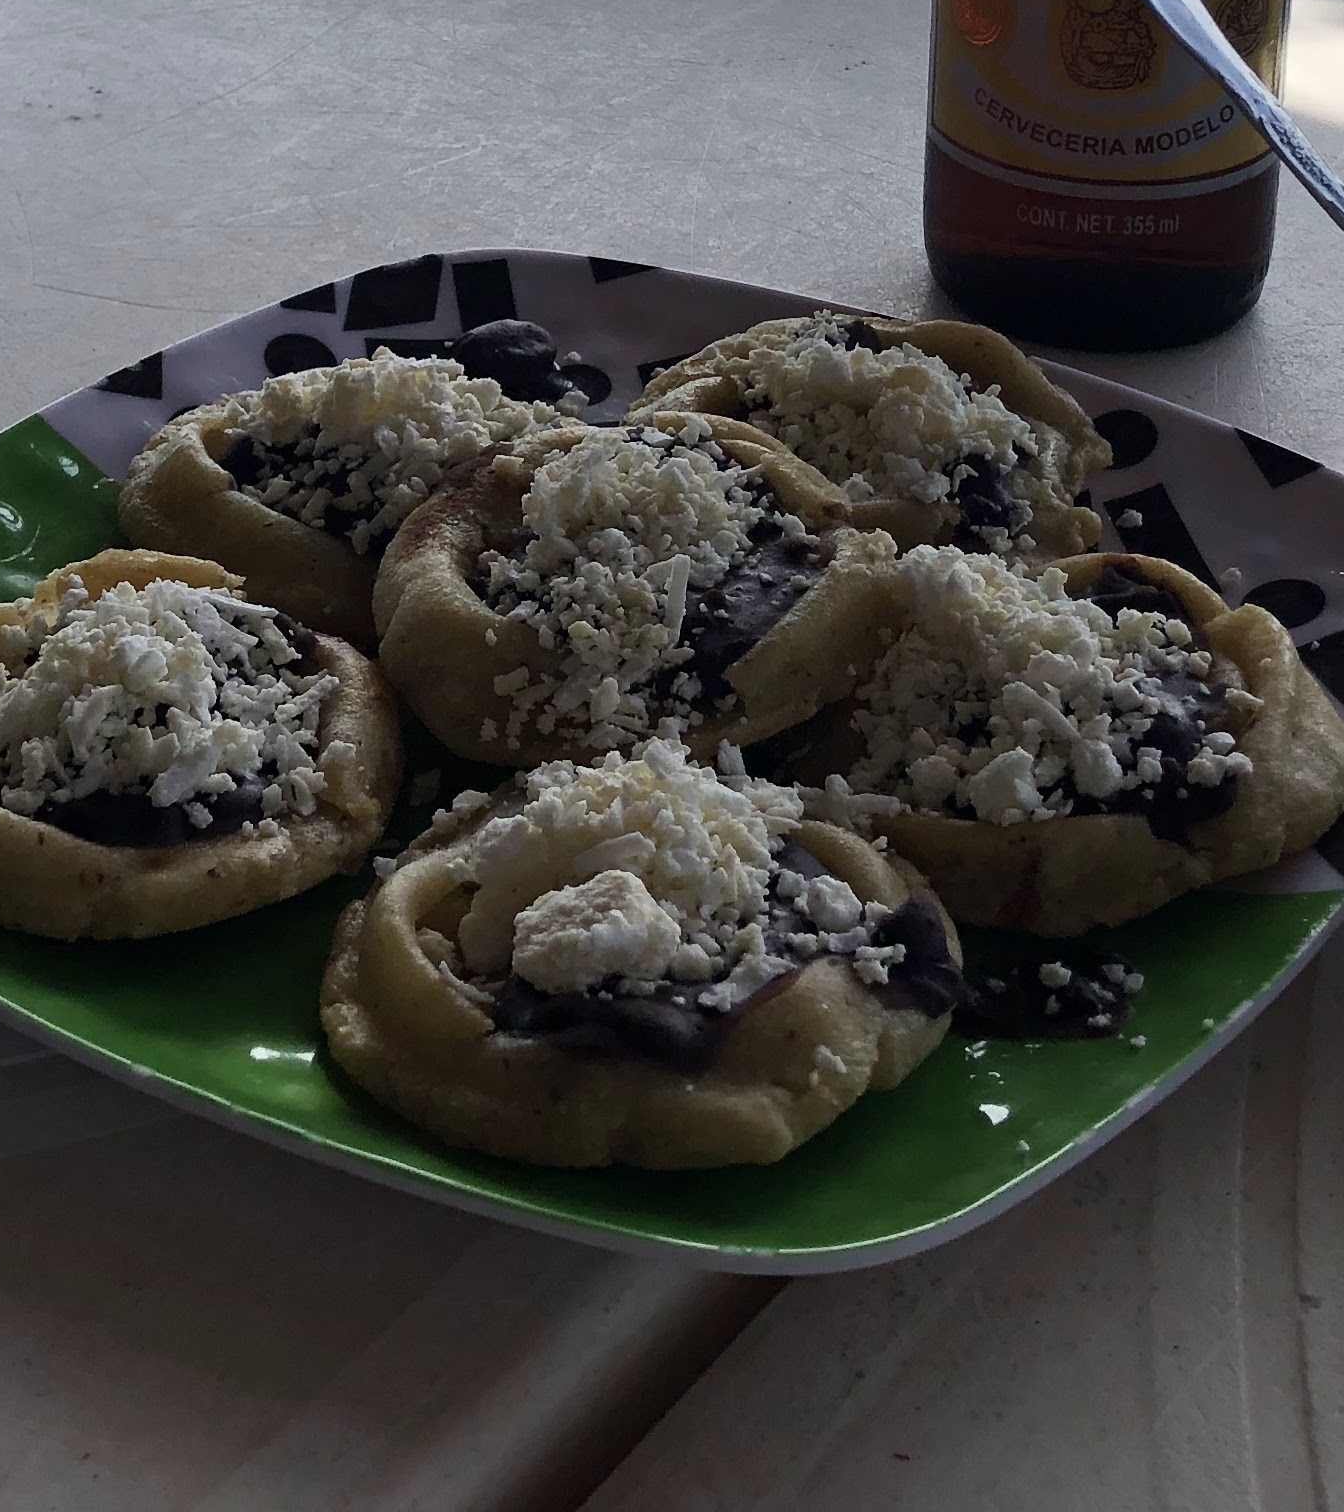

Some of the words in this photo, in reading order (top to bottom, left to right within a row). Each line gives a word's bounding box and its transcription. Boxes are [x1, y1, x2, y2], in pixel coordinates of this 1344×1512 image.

[973, 87, 1127, 156] CERVECERIA
[1134, 103, 1235, 156] MODELO
[1122, 214, 1155, 236] 355
[1158, 212, 1180, 234] ml
